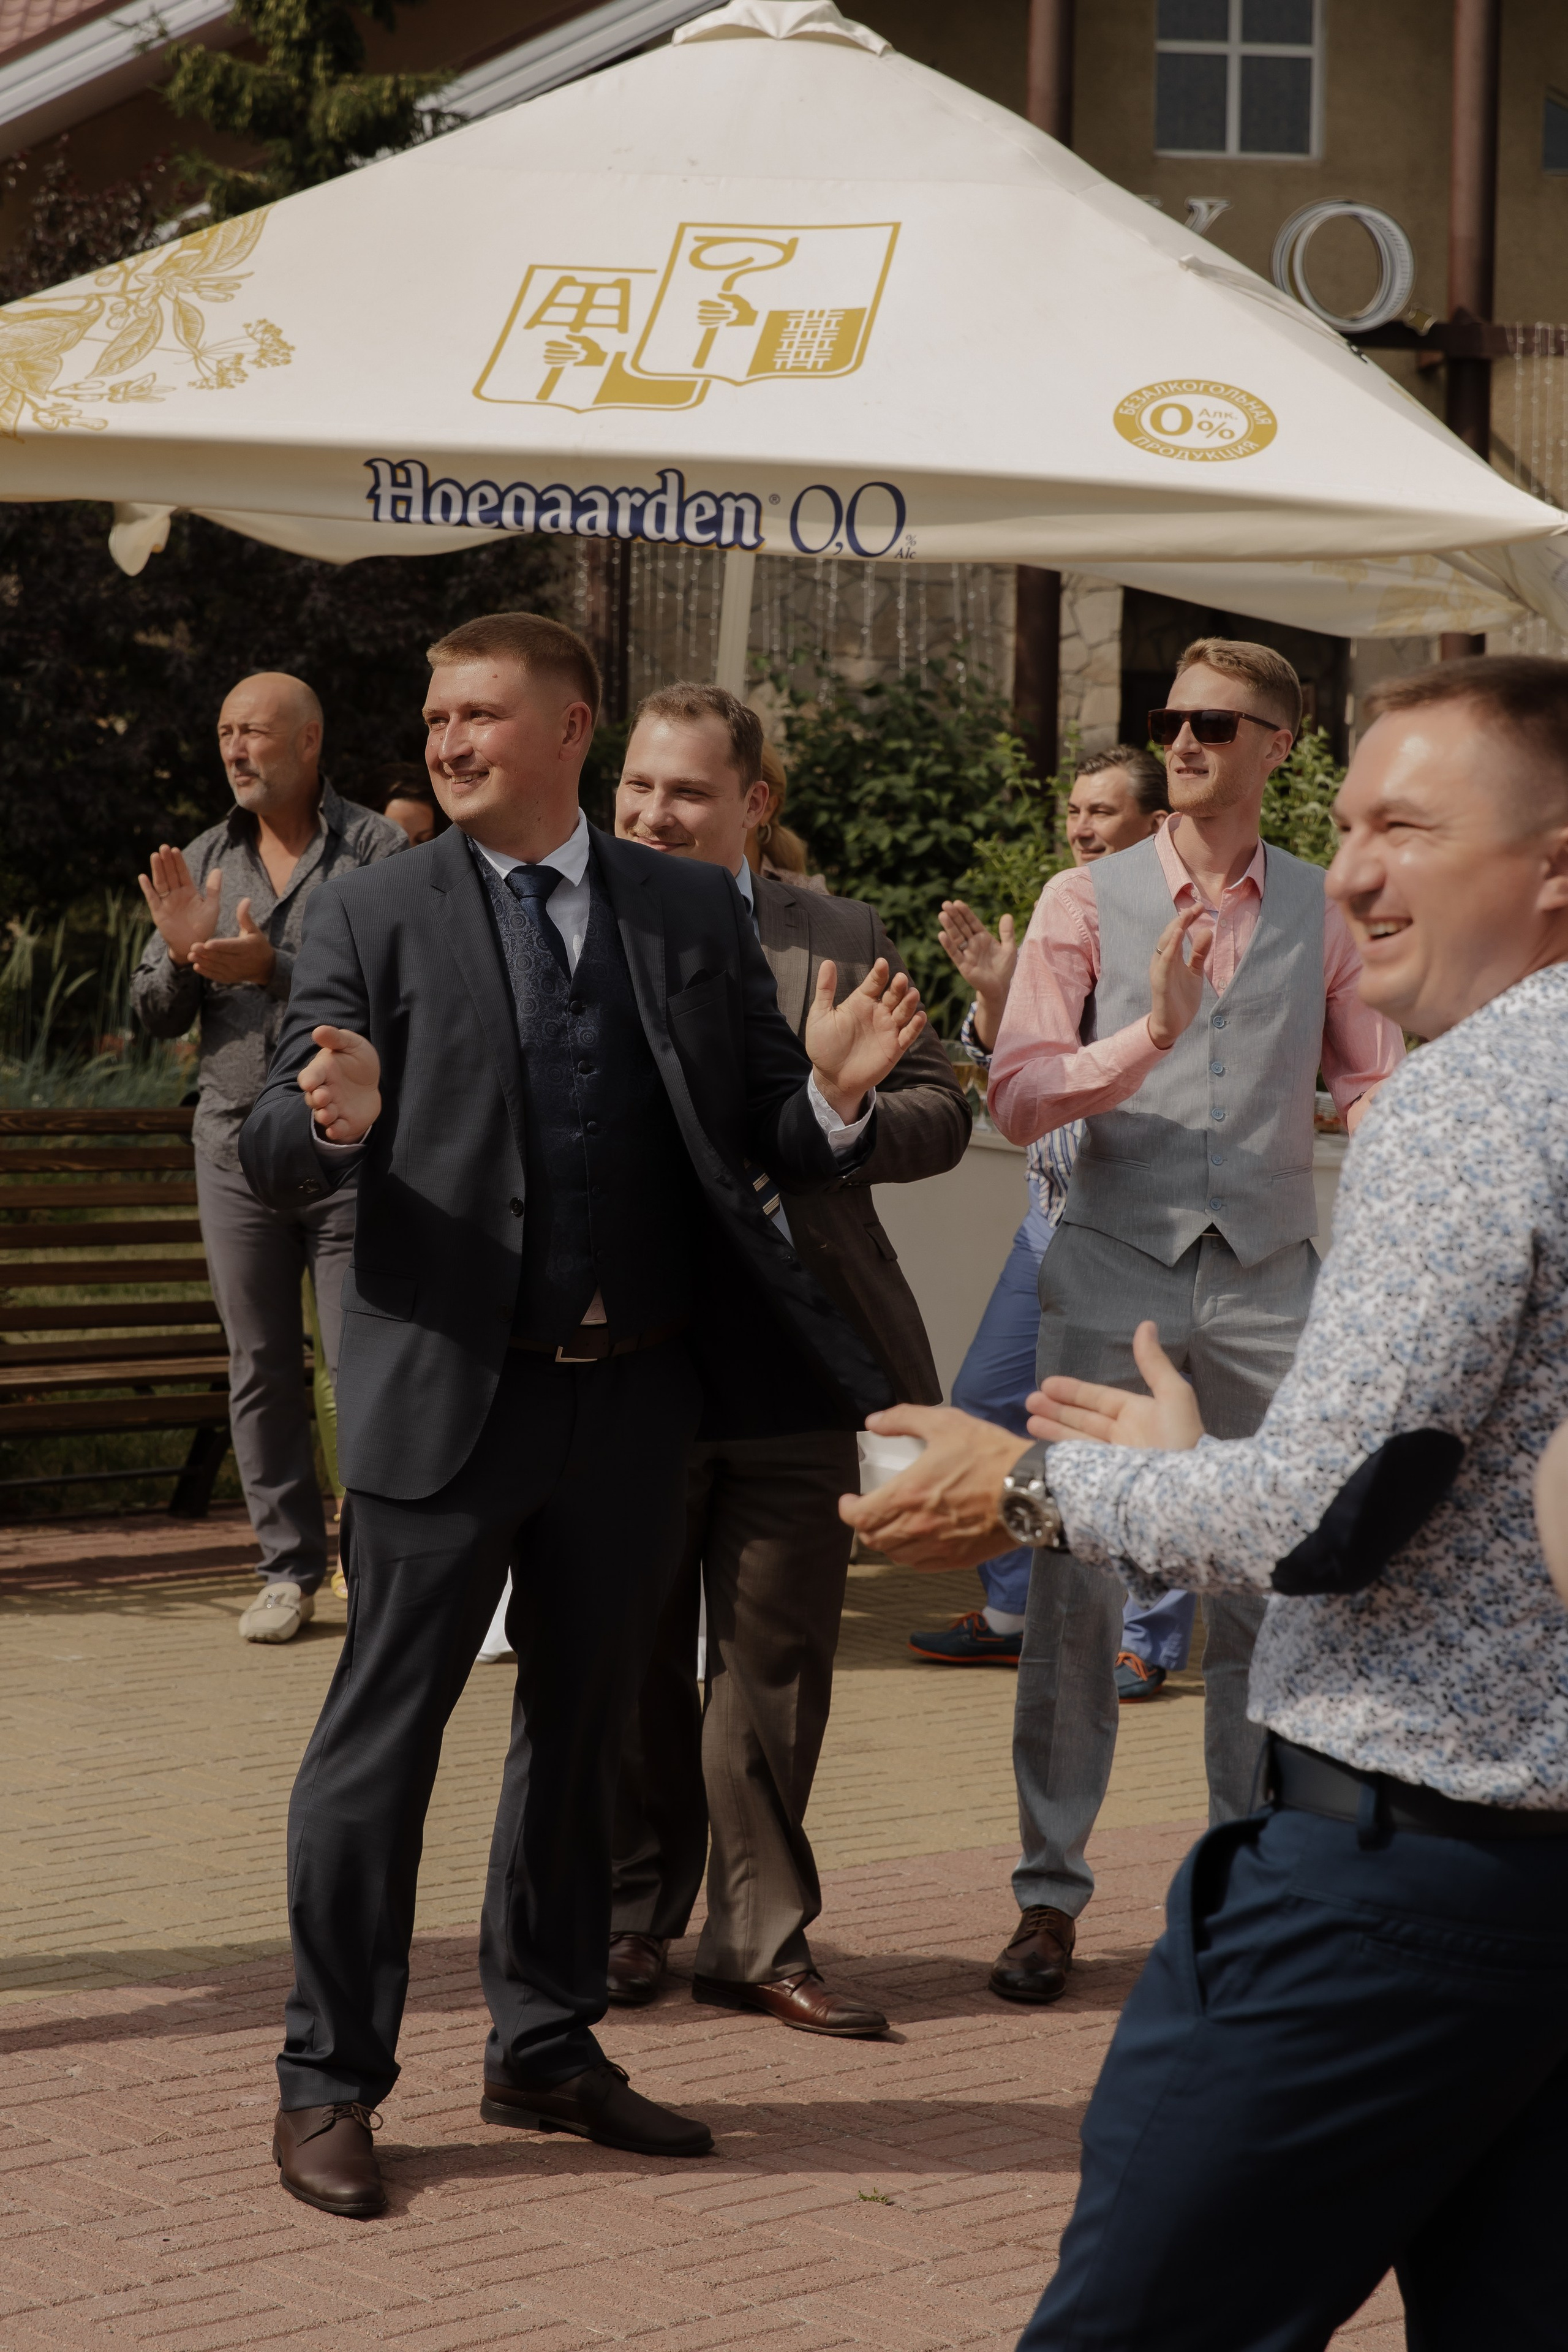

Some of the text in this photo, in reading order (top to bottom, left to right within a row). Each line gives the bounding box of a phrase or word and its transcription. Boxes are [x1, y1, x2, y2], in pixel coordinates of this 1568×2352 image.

[1119, 380, 1272, 425] БЕЗАЛКОГОЛЬНАЯ
[1132, 436, 1260, 461] ПРОДУКЦИЯ
[363, 458, 764, 550] Hoegaarden
